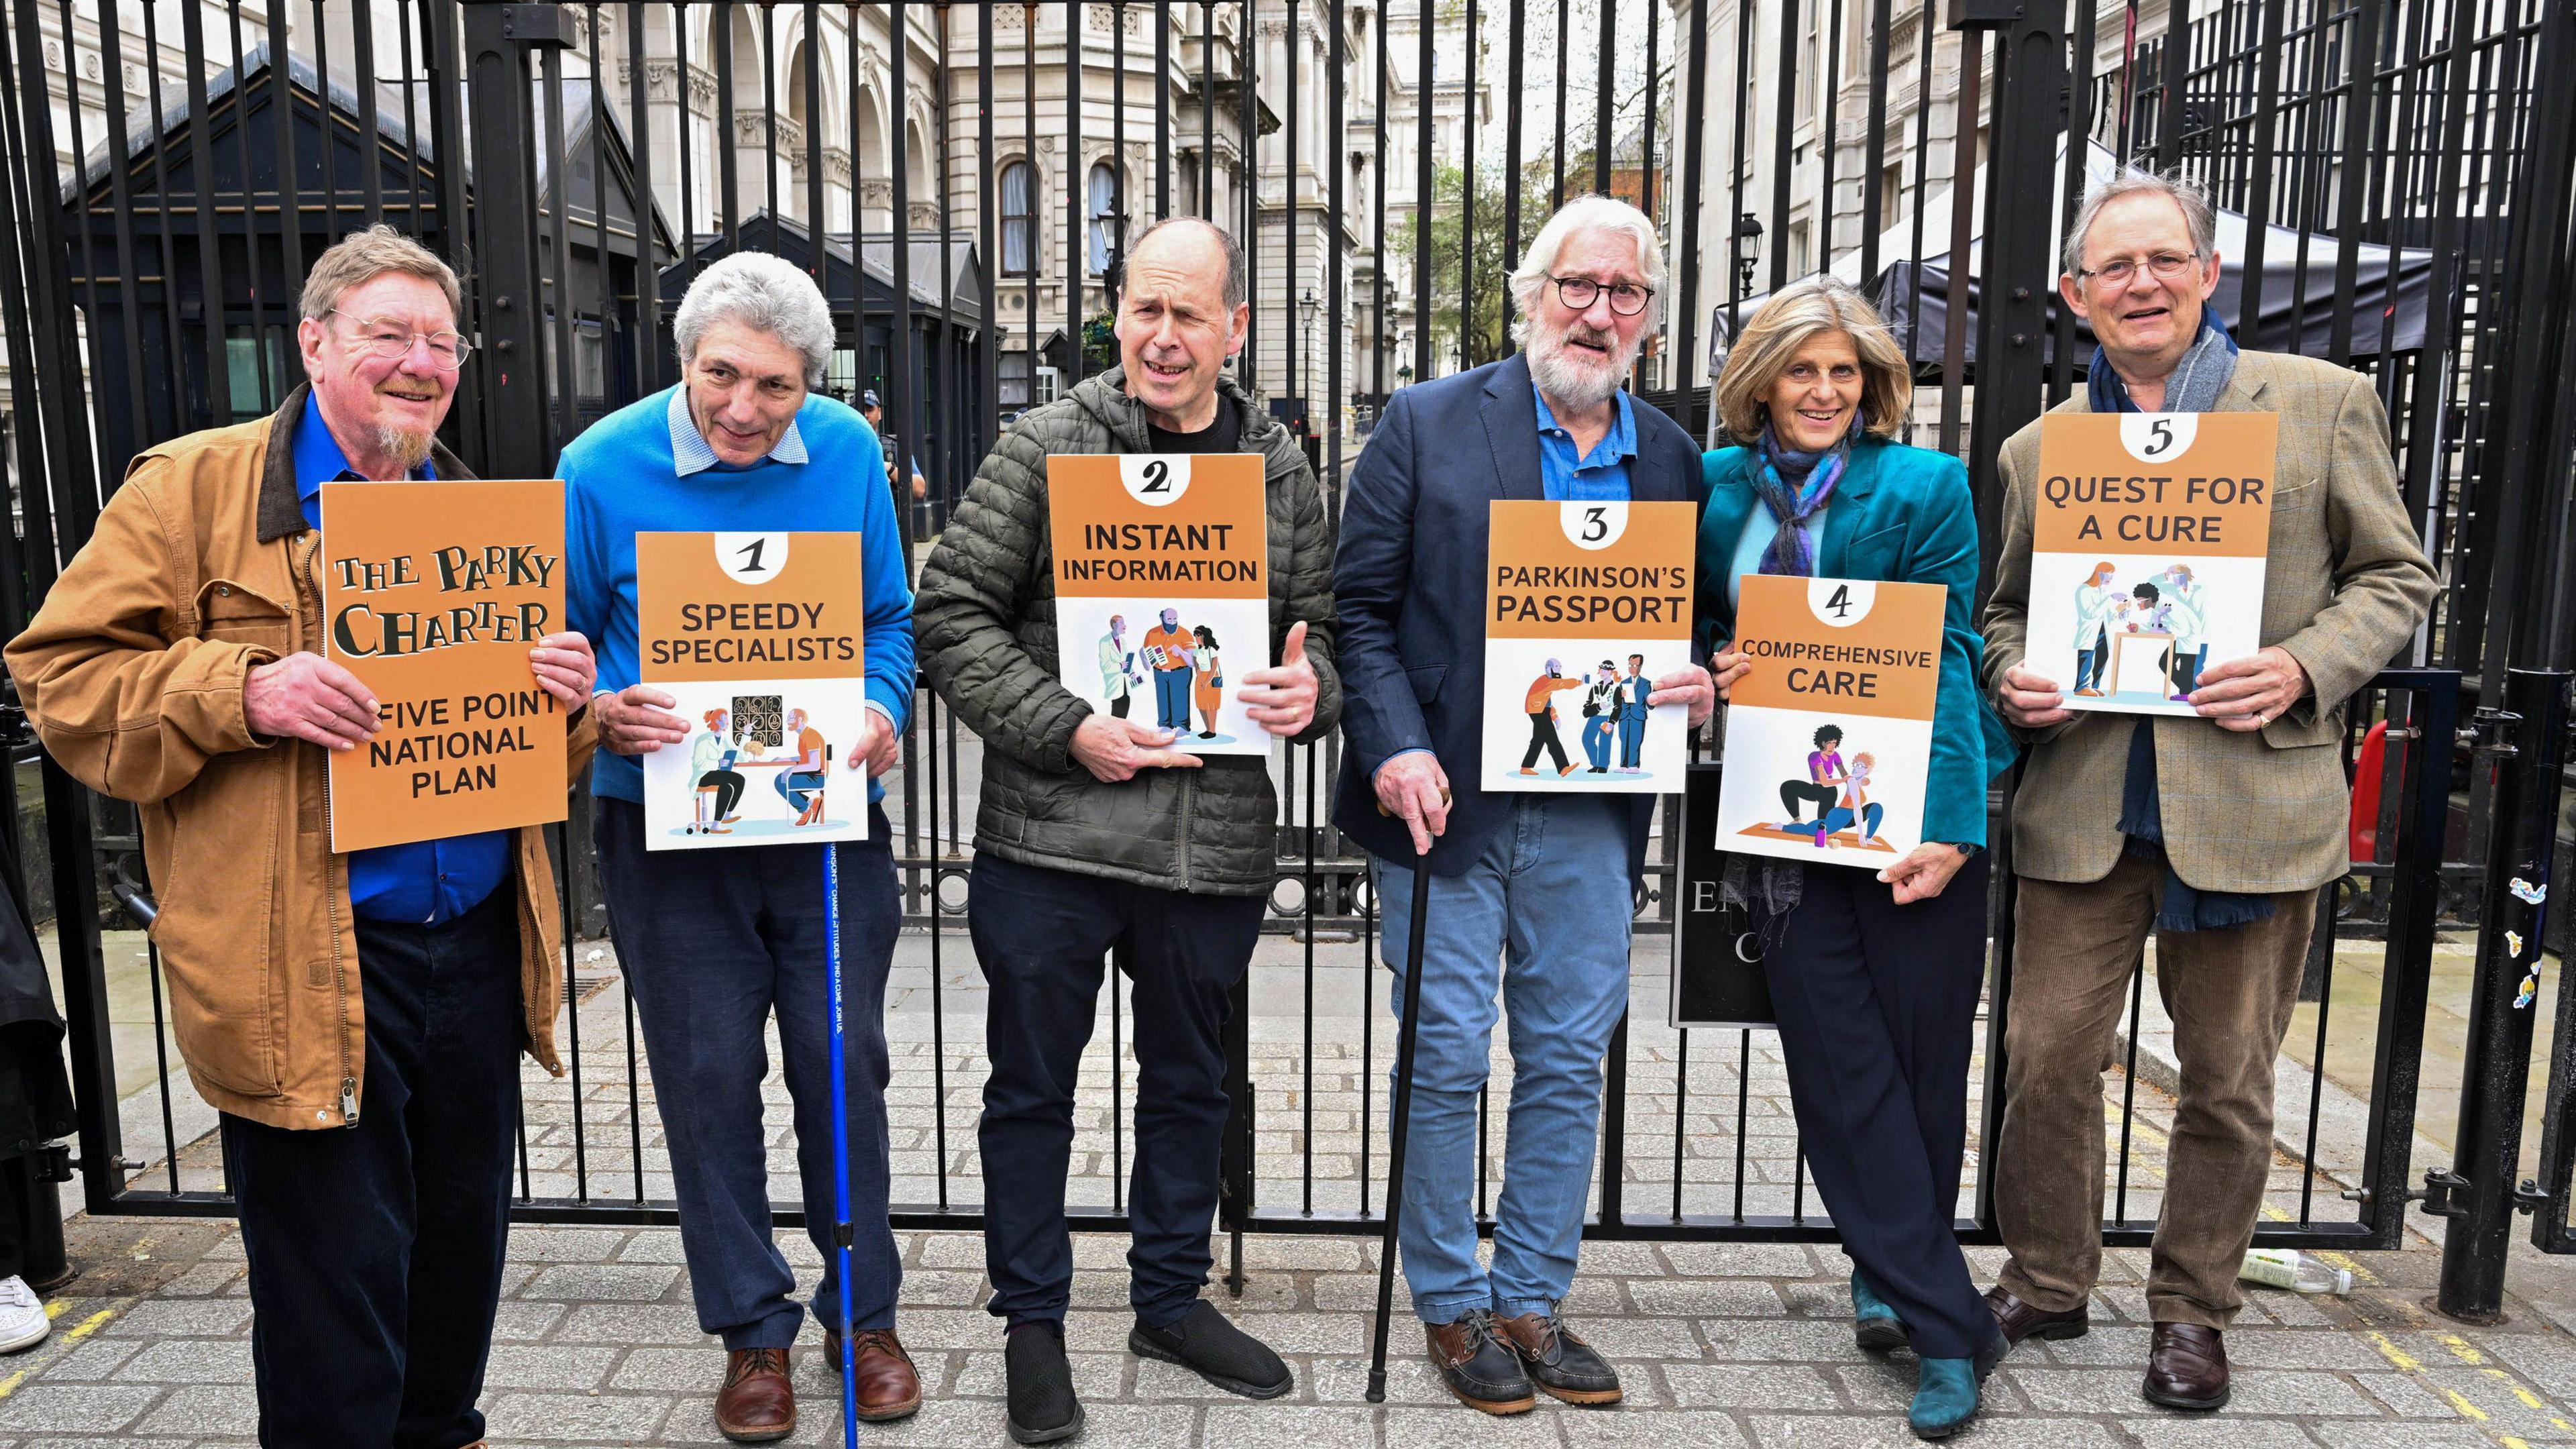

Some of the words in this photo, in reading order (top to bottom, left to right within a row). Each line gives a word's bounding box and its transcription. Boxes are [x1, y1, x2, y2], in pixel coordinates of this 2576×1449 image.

[2145, 419, 2173, 455] 5
[1140, 460, 1172, 493] 2
[2045, 476, 2172, 508] QUEST
[2186, 477, 2264, 504] FOR
[1085, 524, 1233, 551] INSTANT
[1581, 507, 1608, 541] 3
[2078, 515, 2102, 540] A
[2118, 515, 2222, 543] CURE
[334, 555, 420, 591] THE
[431, 545, 558, 593] PARKY
[736, 537, 766, 572] 1
[1063, 559, 1257, 582] INFORMATION
[1497, 566, 1686, 589] PARKINSON'S
[682, 602, 824, 632] SPEEDY
[1497, 595, 1686, 623] PASSPORT
[1825, 584, 1853, 618] 4
[333, 602, 548, 658] CHARTER
[651, 636, 855, 665] SPECIALISTS
[1742, 639, 1931, 668] COMPREHENSIVE
[1787, 667, 1878, 698] CARE
[378, 698, 449, 729] FIVE
[464, 689, 553, 722] POINT
[370, 726, 535, 768] NATIONAL
[412, 763, 496, 798] PLAN
